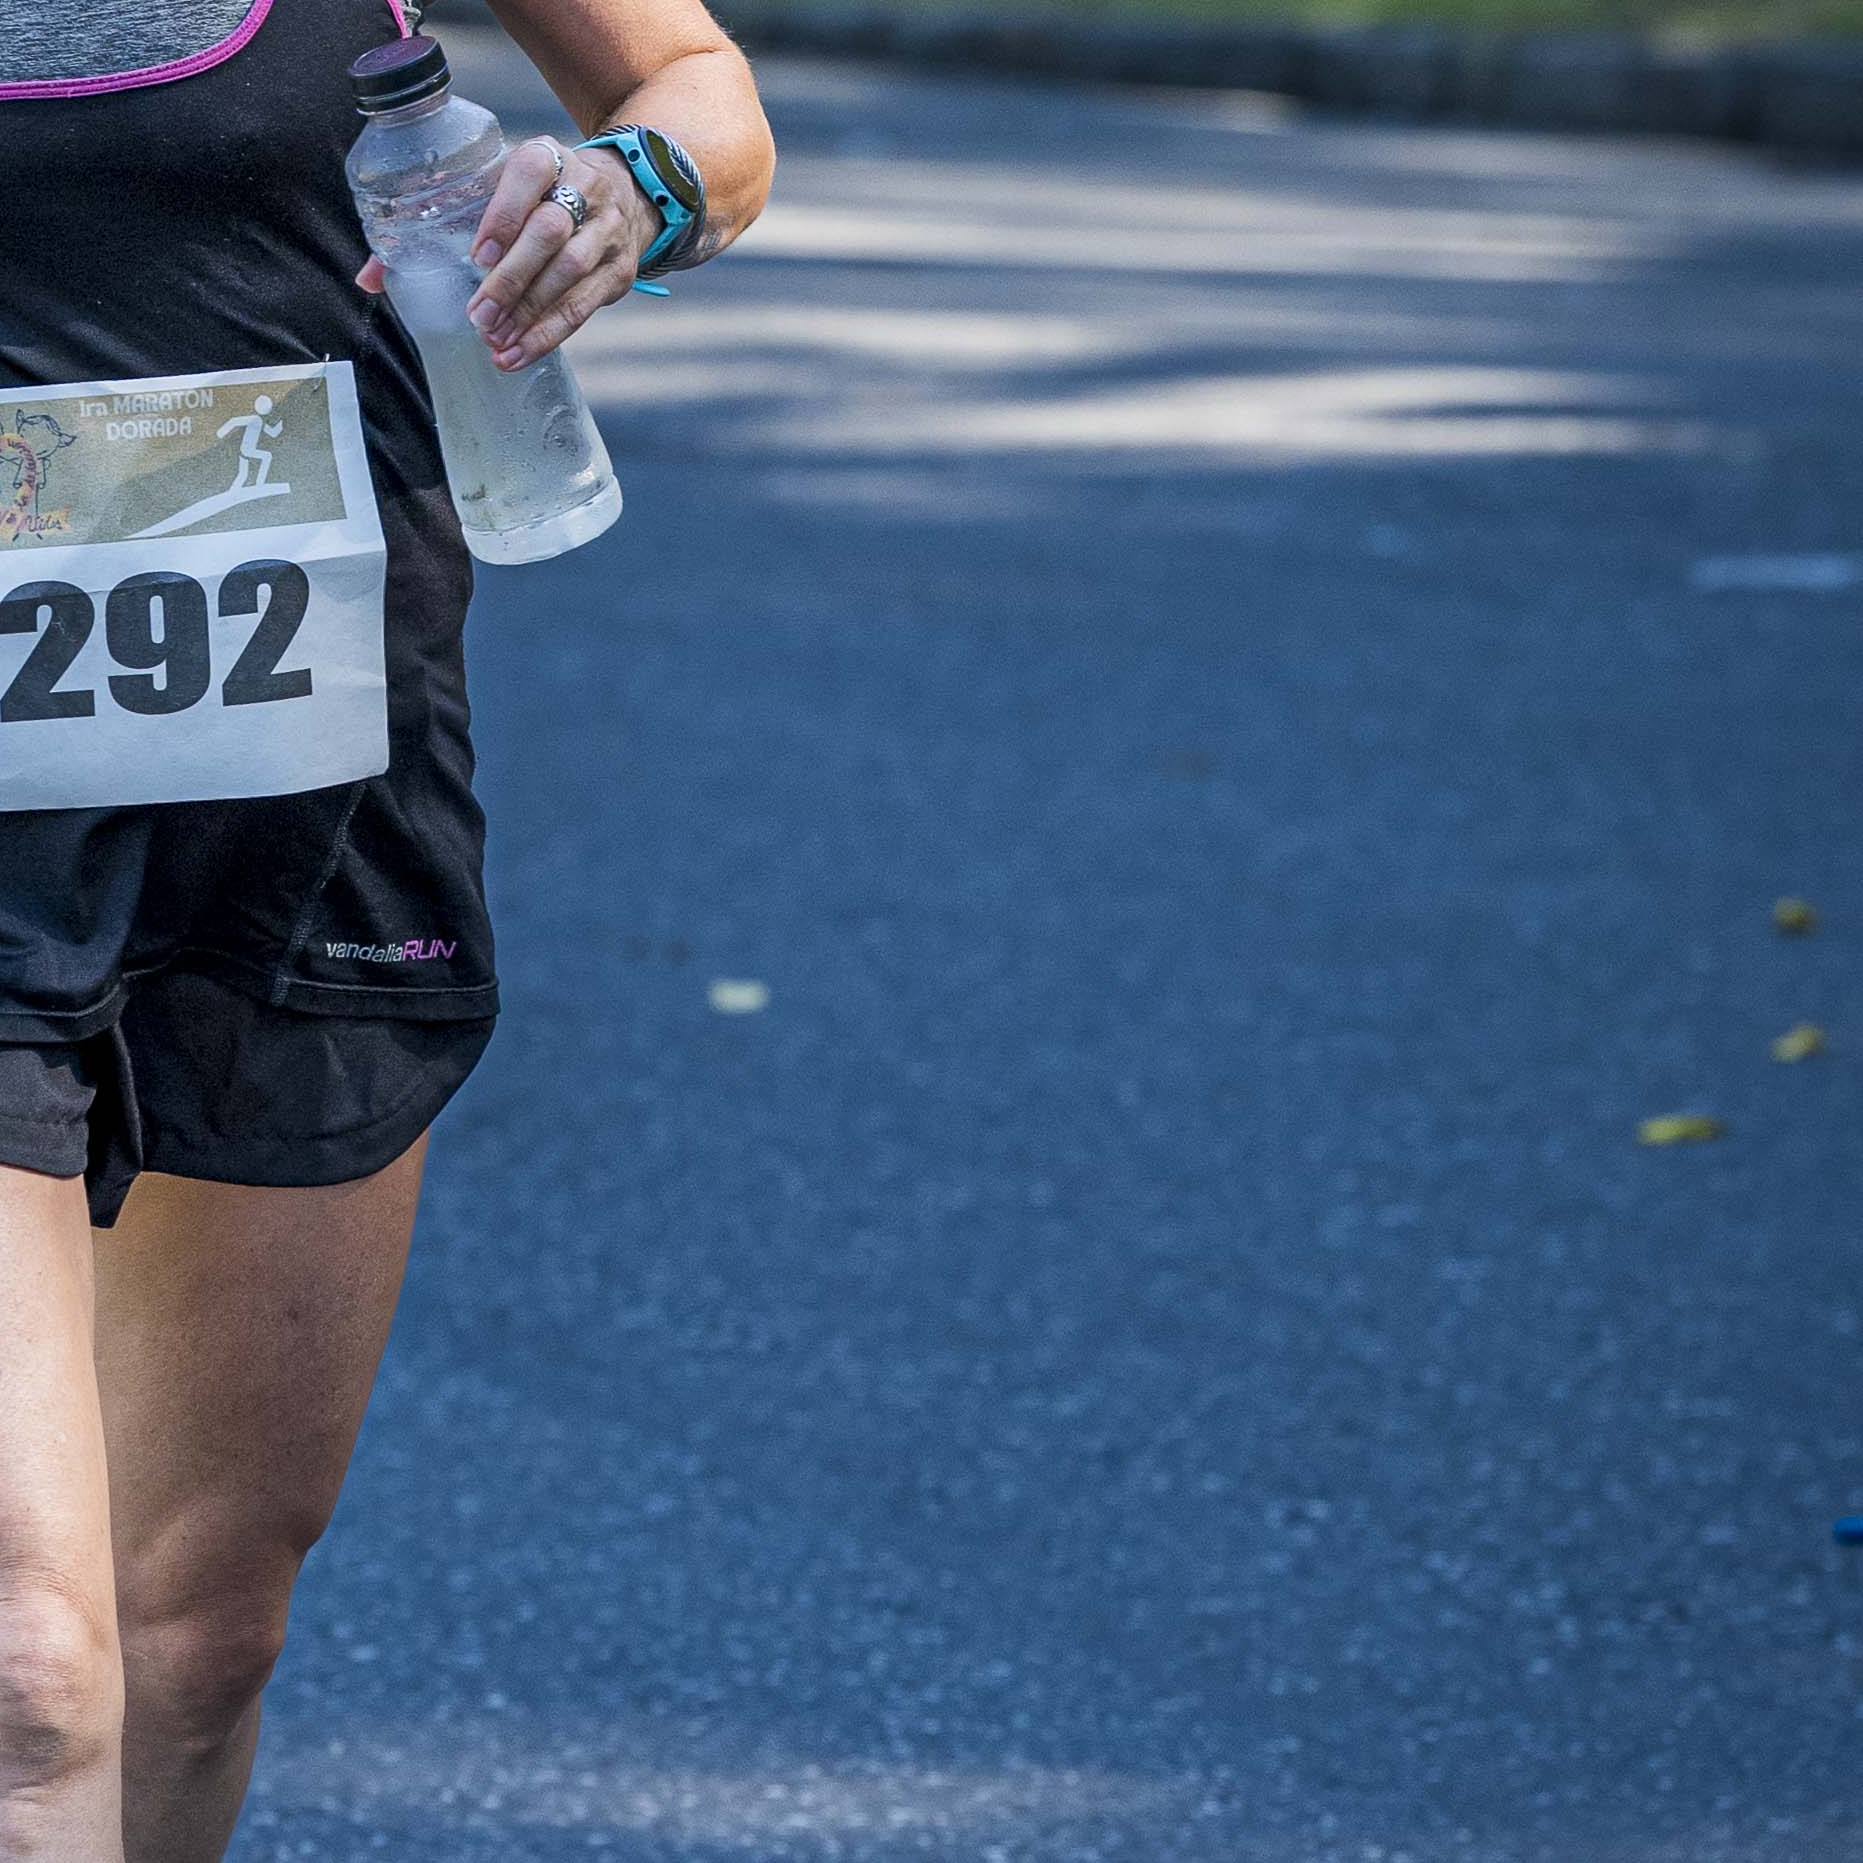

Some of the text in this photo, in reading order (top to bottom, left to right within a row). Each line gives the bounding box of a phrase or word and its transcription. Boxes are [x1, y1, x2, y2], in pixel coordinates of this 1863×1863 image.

[113, 389, 214, 415] MARATON
[106, 416, 192, 441] DORADA
[325, 939, 457, 963] vandaliaRUN
